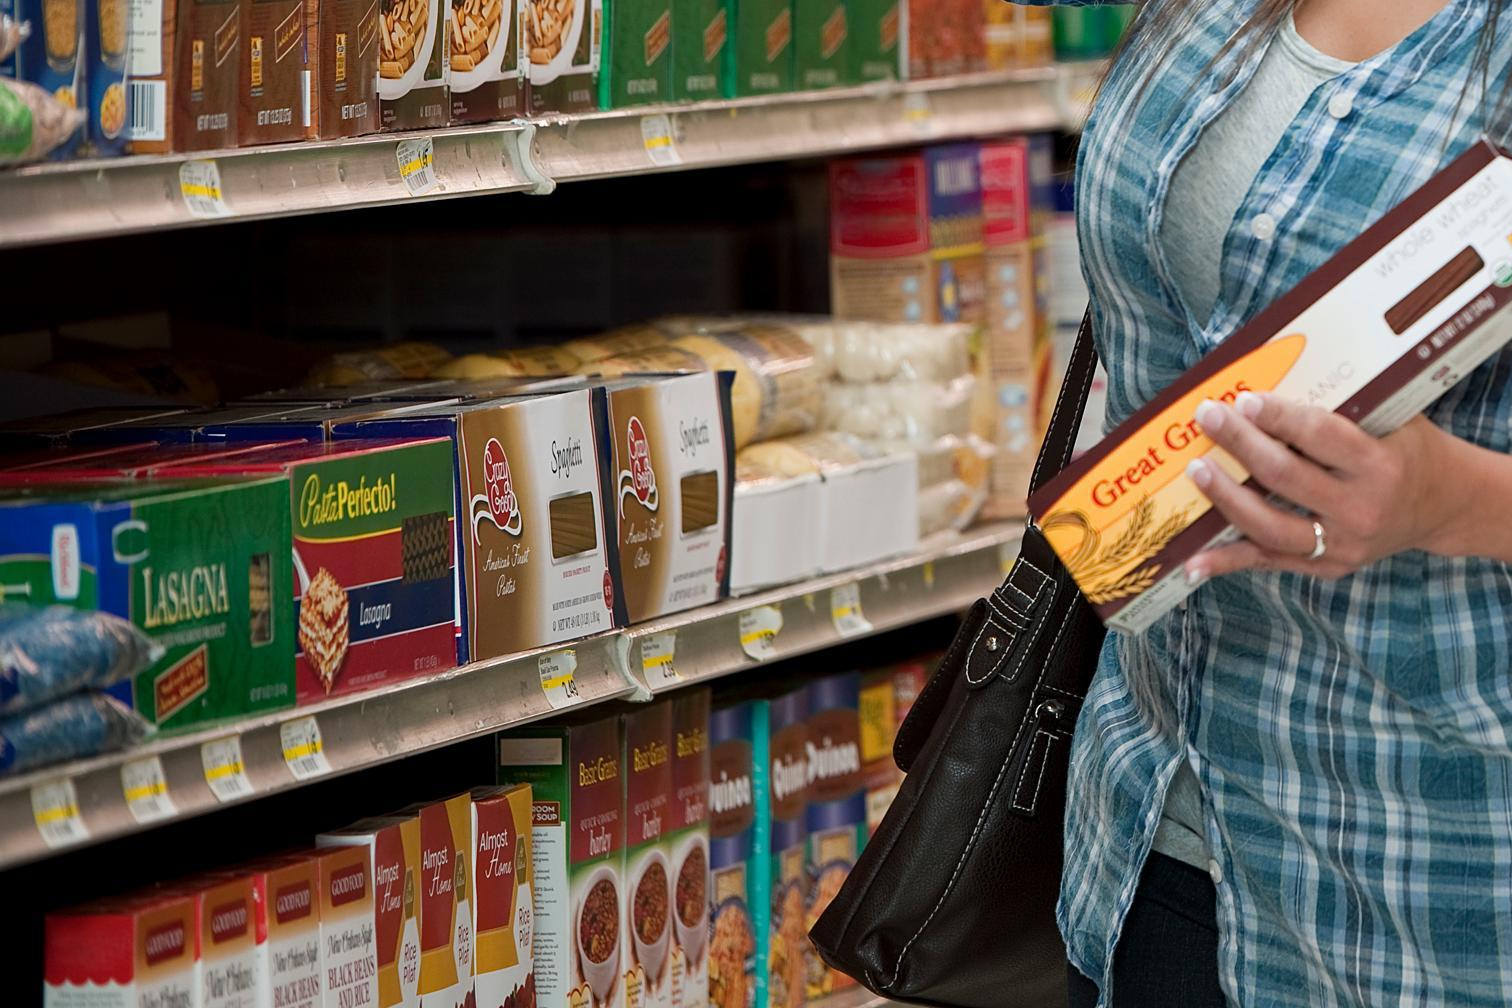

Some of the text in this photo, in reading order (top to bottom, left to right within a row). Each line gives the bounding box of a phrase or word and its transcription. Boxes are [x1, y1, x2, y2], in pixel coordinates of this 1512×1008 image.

[1374, 174, 1498, 278] whole wheat
[679, 415, 710, 457] Spaghetti
[1091, 378, 1254, 509] Great Grns
[485, 444, 508, 484] Crazy
[551, 436, 583, 479] Spaghetti
[490, 481, 515, 515] Good
[483, 543, 531, 572] America's Finest
[142, 562, 230, 629] LASAGNA
[359, 601, 392, 630] Lasagna
[561, 679, 580, 699] 2.49
[578, 754, 618, 788] Basic Grains
[633, 747, 650, 773] Basic
[649, 741, 669, 766] Grains
[708, 769, 752, 814] uinoa
[532, 805, 556, 815] ROOM
[536, 813, 558, 822] SOUP
[478, 828, 509, 854] Almost
[642, 810, 662, 843] barley
[589, 824, 613, 860] barley
[422, 848, 449, 870] Almost
[484, 849, 513, 879] Home
[331, 871, 364, 897] GOOD FOOD
[376, 864, 400, 887] Almost
[428, 865, 452, 897] Home
[276, 889, 311, 915] GOOD FOOD
[381, 880, 402, 914] Home
[212, 908, 247, 934] GOOD FOOD
[518, 906, 531, 927] Rice
[327, 921, 374, 959] New Orleans Style
[457, 925, 469, 945] Rice
[519, 926, 530, 949] Pilaf
[272, 951, 288, 977] New
[287, 946, 307, 973] Orleans
[403, 943, 417, 963] Rice
[458, 947, 470, 969] Pilaf
[327, 954, 376, 991] BLACK BEANS
[403, 962, 417, 985] Pilaf
[273, 973, 320, 1008] BLACK BEANS
[338, 981, 371, 1008] AND RICE
